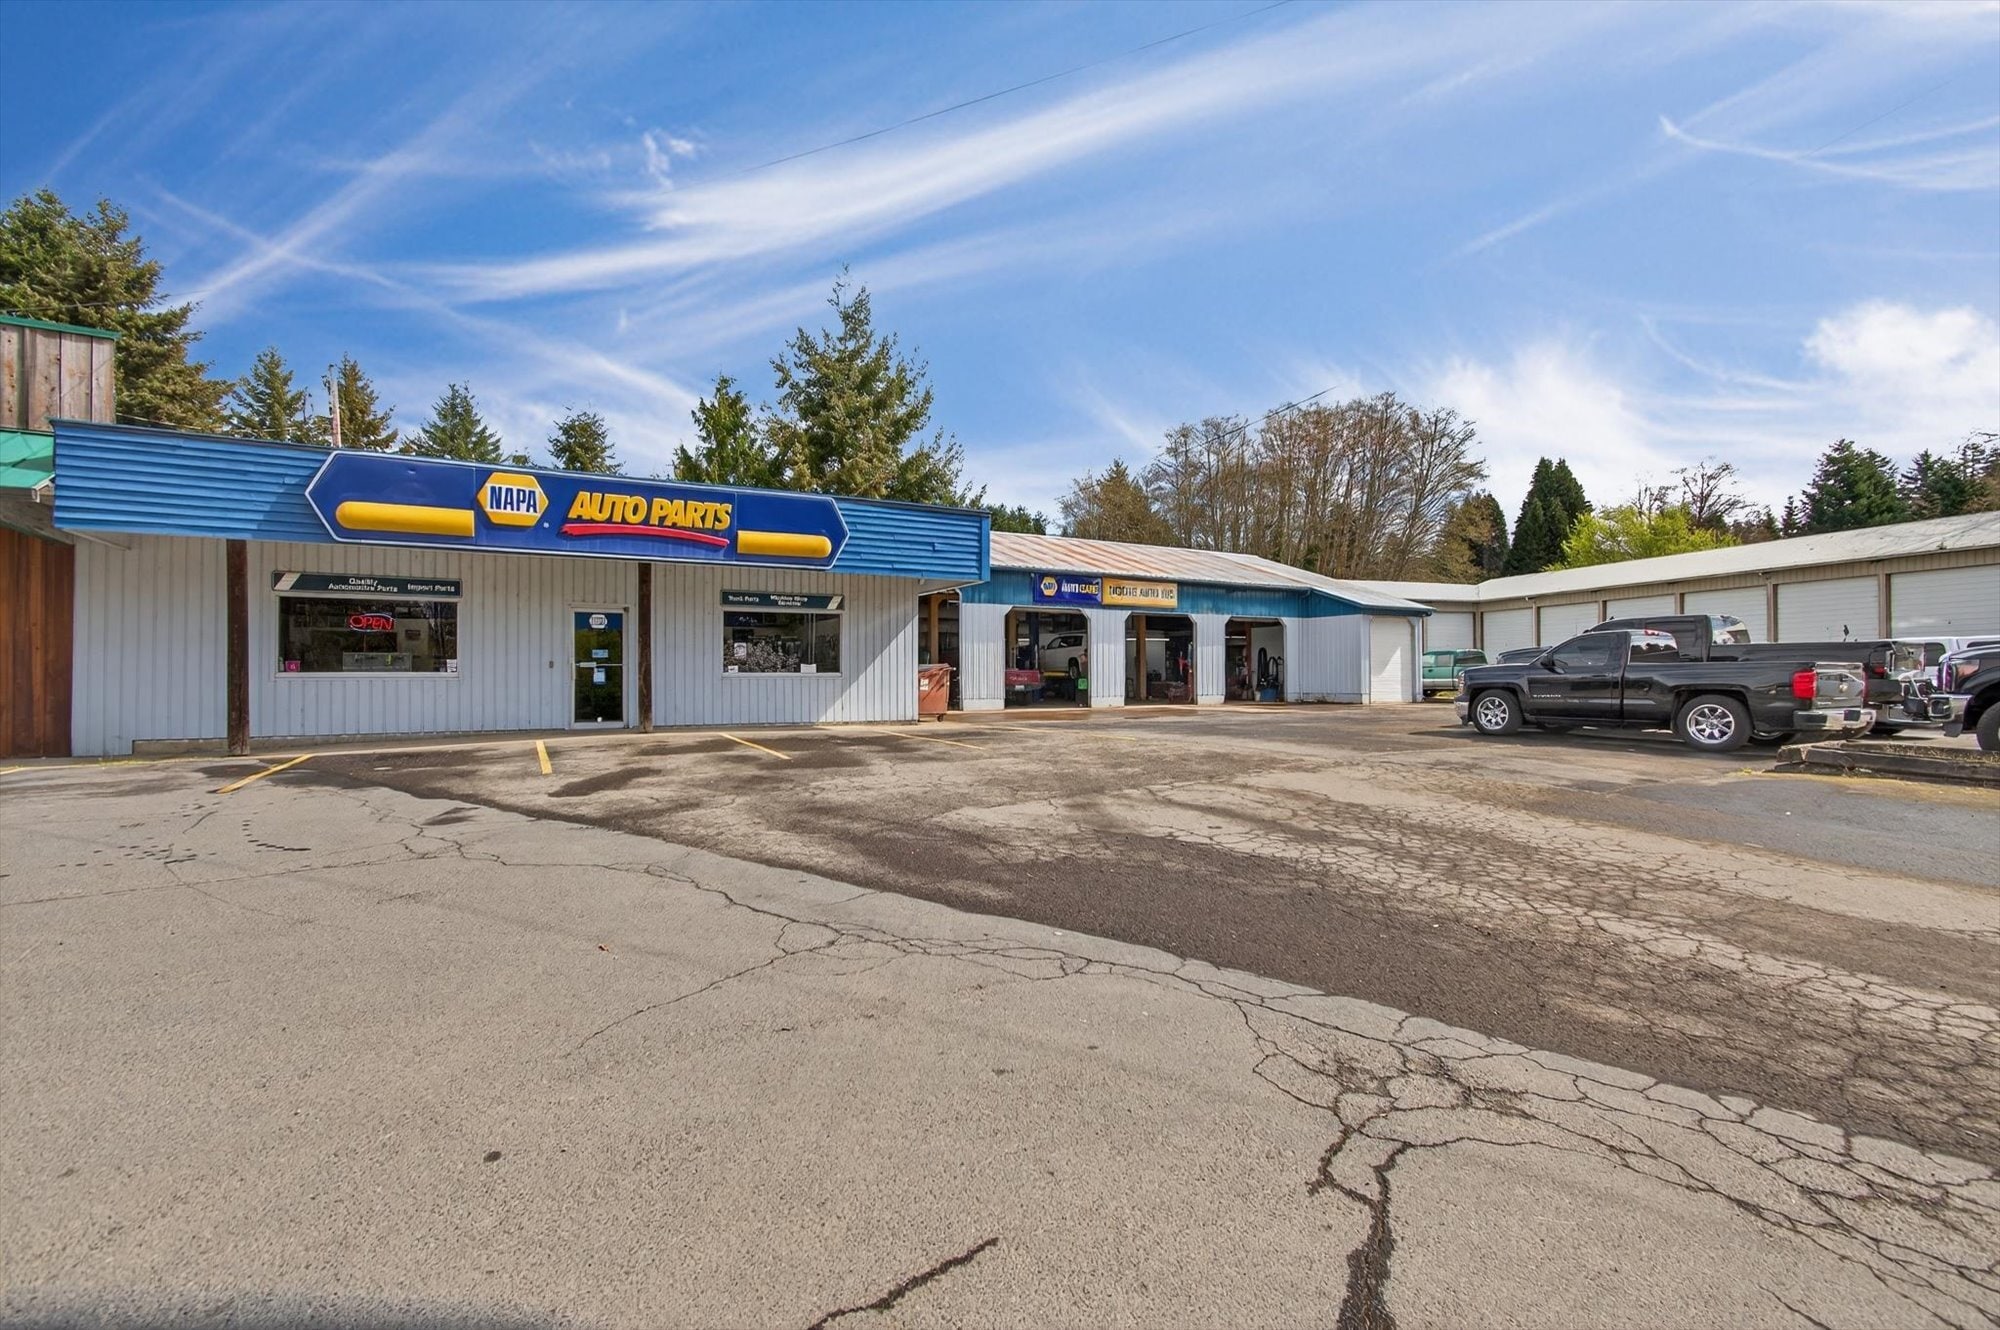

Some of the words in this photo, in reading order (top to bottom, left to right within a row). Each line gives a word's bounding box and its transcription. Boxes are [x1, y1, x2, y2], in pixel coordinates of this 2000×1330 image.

[489, 485, 538, 513] NAPA
[567, 491, 648, 524] AUTO
[650, 498, 732, 531] PARTS
[349, 577, 379, 587] Quality
[376, 585, 399, 593] Parts
[350, 615, 392, 630] OPEN
